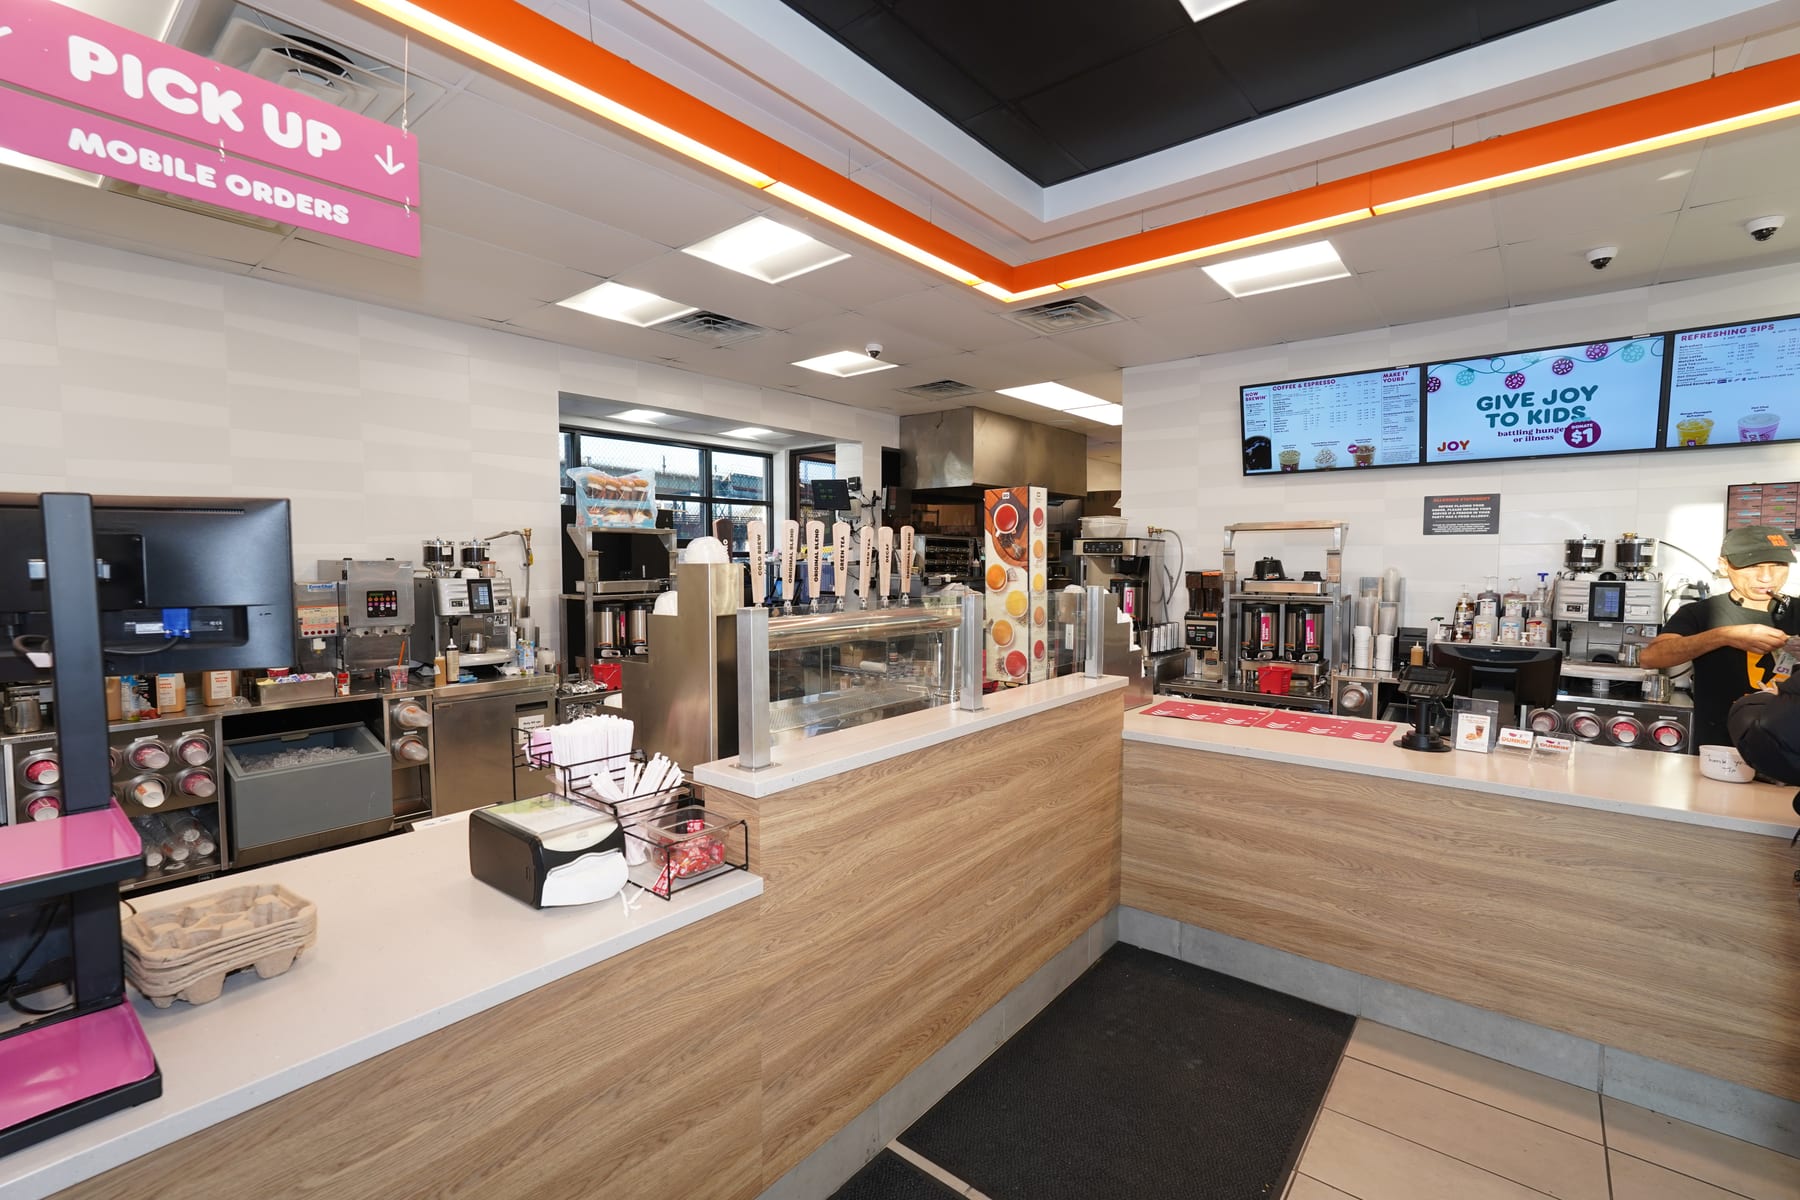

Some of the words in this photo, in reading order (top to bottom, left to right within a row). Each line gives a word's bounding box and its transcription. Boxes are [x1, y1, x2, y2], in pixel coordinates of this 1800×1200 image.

[67, 34, 245, 133] PICK
[262, 102, 343, 159] UP
[67, 127, 218, 189] MOBILE
[224, 173, 350, 226] ORDERS
[1681, 327, 1748, 342] REFRESHING
[1750, 324, 1775, 333] SIPS
[1304, 379, 1336, 387] ESPRESSO
[1476, 391, 1535, 411] GIVE
[1542, 384, 1599, 406] JOY
[1485, 412, 1520, 428] TO
[1527, 405, 1586, 426] KIDS
[1497, 427, 1534, 438] battling
[1536, 426, 1566, 436] hunge
[1571, 428, 1593, 444] $1
[1437, 440, 1470, 452] JOY
